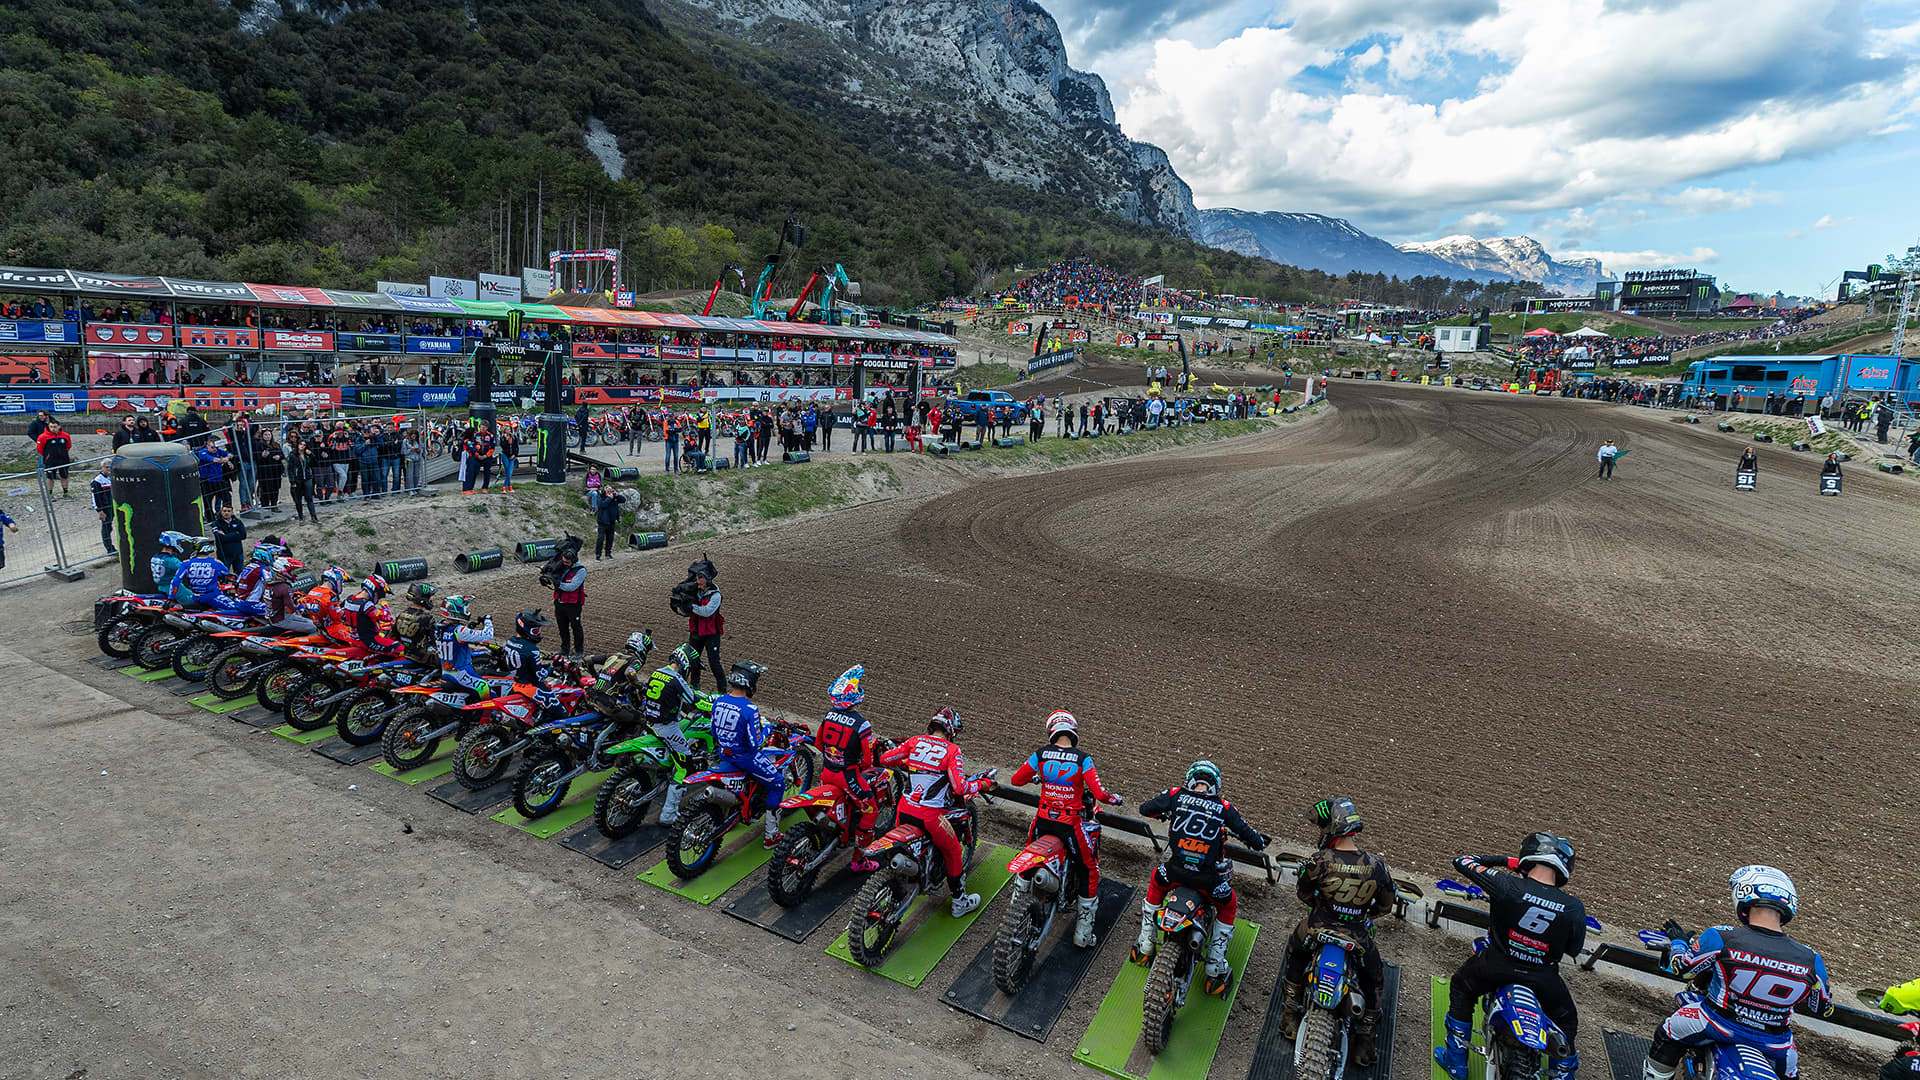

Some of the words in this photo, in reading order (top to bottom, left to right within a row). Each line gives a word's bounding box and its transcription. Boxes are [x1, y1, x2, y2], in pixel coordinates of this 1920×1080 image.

[276, 333, 323, 342] Beta
[497, 345, 526, 355] MONSTER
[890, 361, 908, 369] LANE
[280, 391, 330, 399] Beta
[188, 567, 212, 578] 303
[396, 673, 412, 684] 959
[461, 674, 486, 690] FXR
[442, 692, 458, 704] 811
[646, 679, 666, 700] 3
[713, 706, 740, 731] 919
[822, 721, 854, 749] 61
[655, 748, 666, 760] 3
[909, 741, 948, 767] 32
[1042, 750, 1079, 762] GUILLOD
[753, 752, 778, 775] UFO
[1042, 760, 1079, 786] 92
[1045, 783, 1075, 792] HONDA
[1177, 837, 1210, 854] KTM
[1324, 877, 1378, 906] 259
[1332, 904, 1362, 915] YAMAHA
[1522, 892, 1566, 912] PATUREL
[1518, 906, 1557, 934] 6
[1509, 948, 1544, 965] YAMAHA
[1729, 950, 1810, 976] VLAANDEREN
[1728, 968, 1808, 1006] 10
